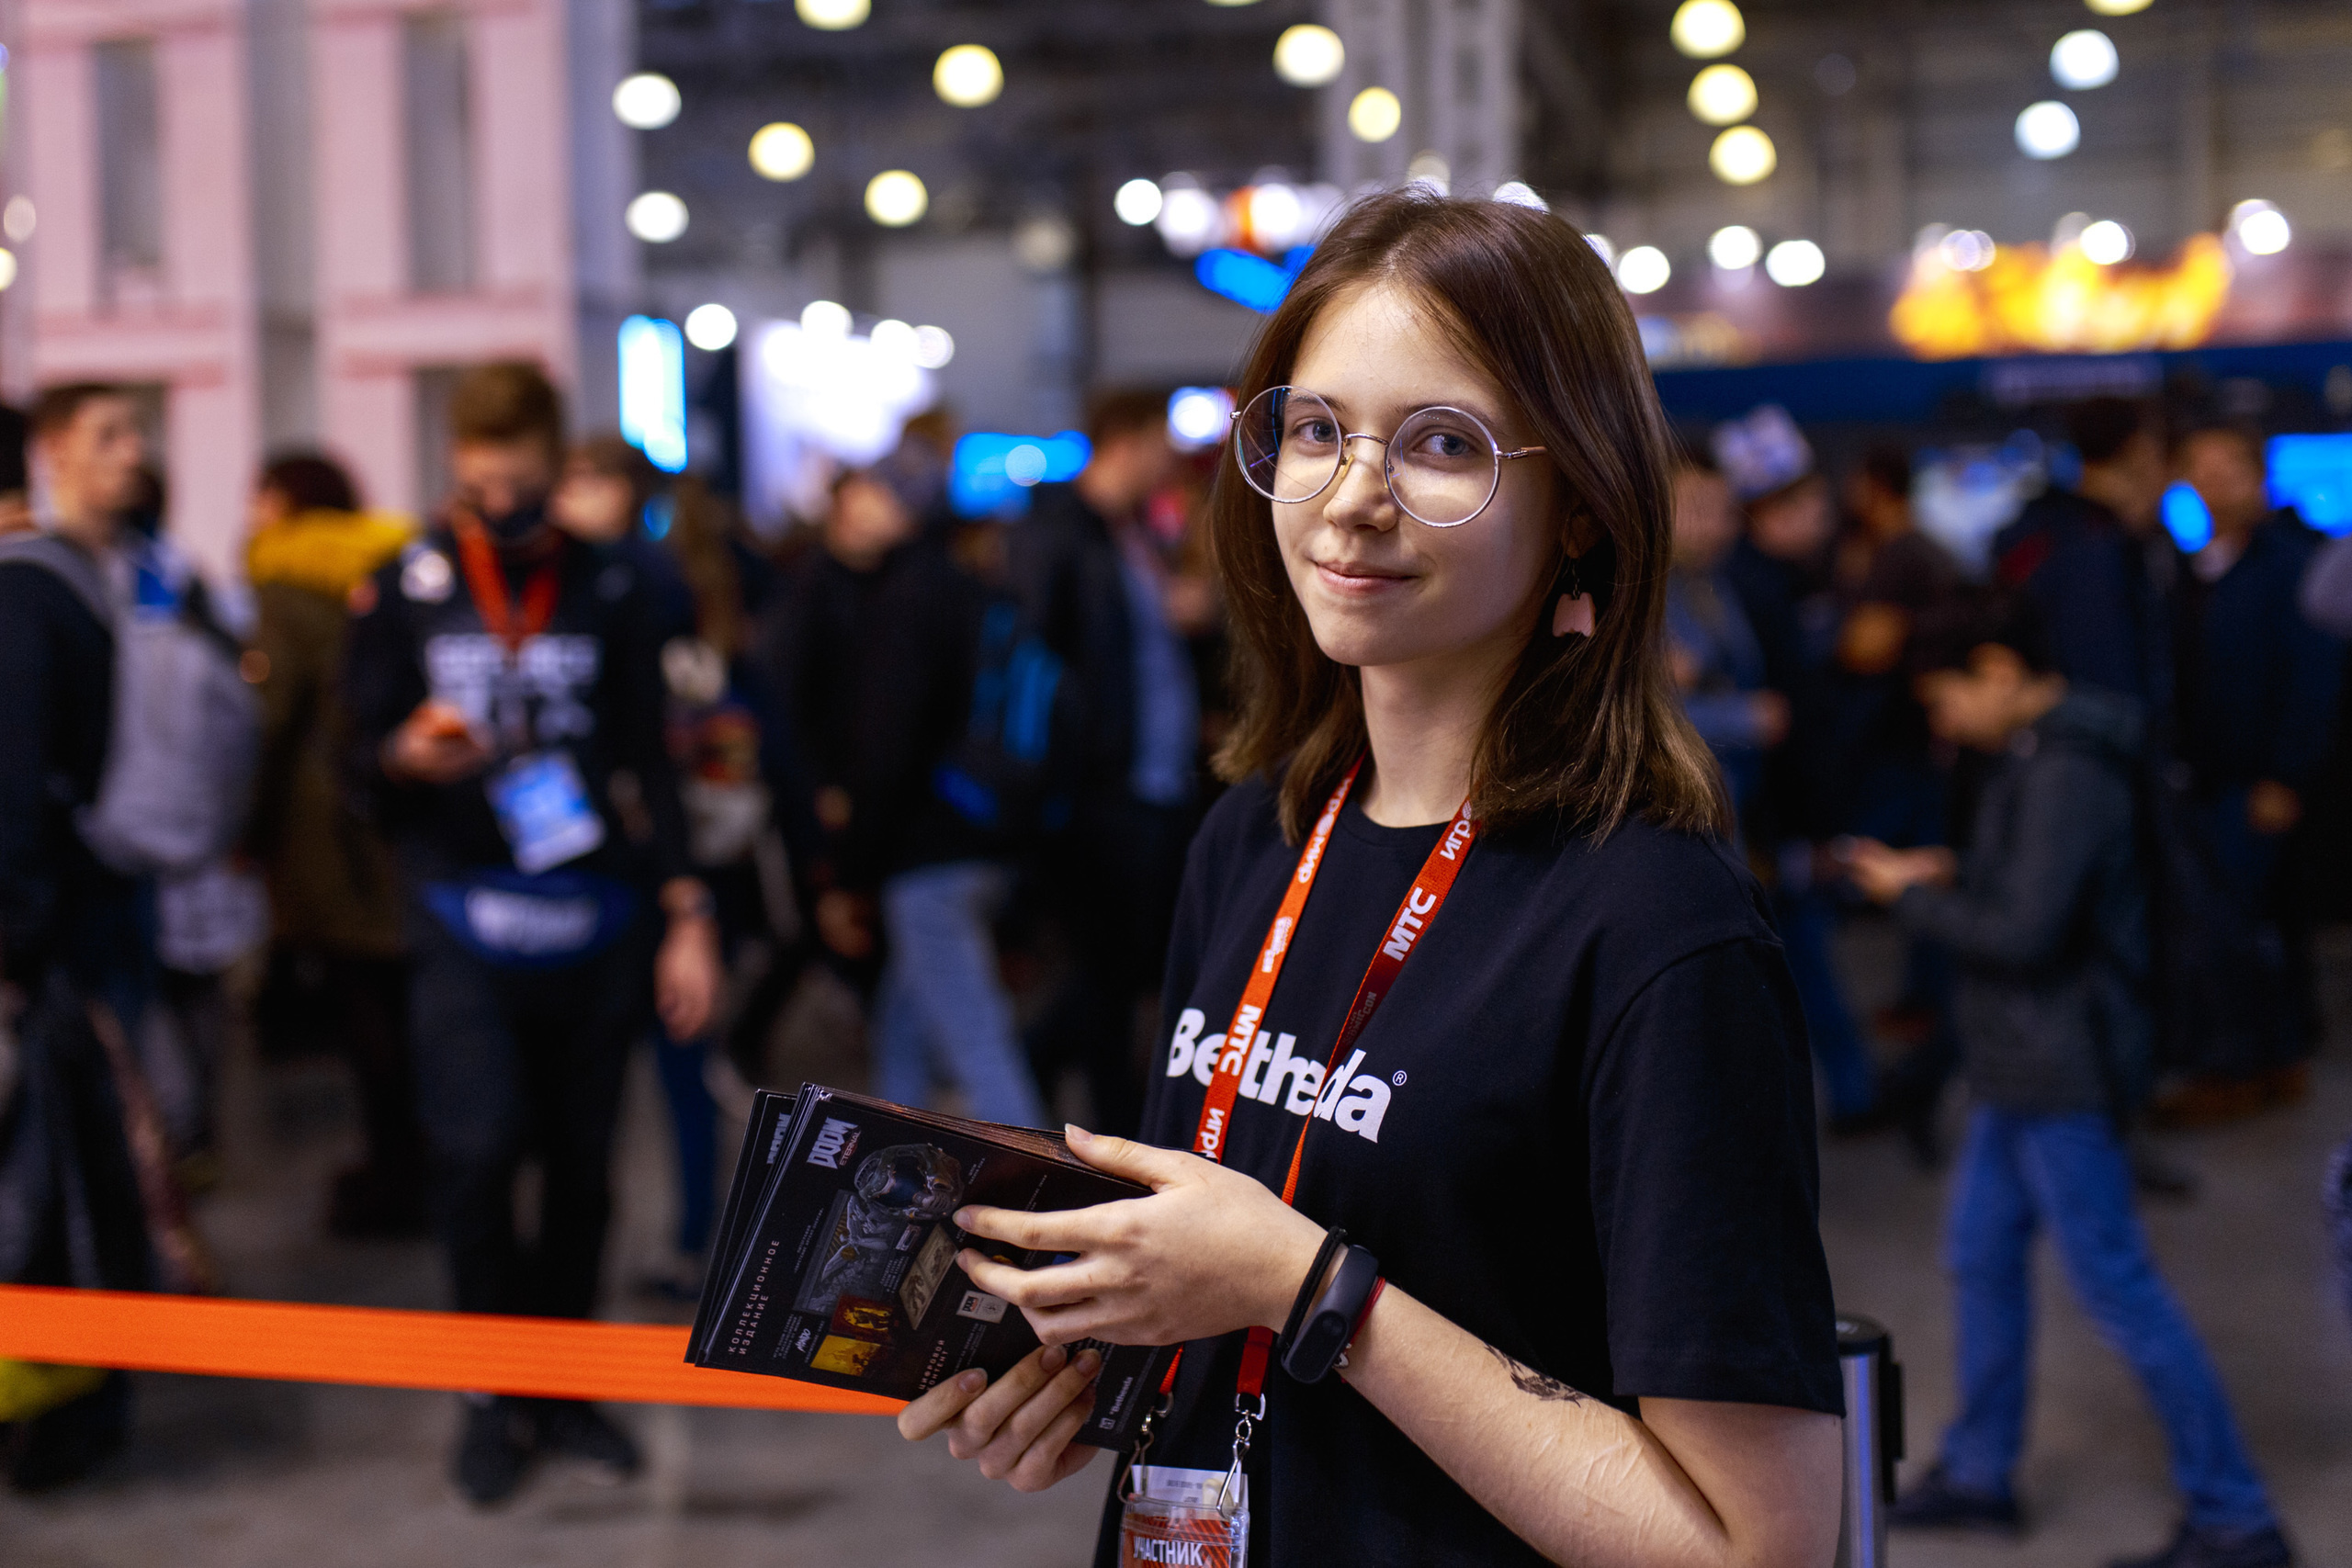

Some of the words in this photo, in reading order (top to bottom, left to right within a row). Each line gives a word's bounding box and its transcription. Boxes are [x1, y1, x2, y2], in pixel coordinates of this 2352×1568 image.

[1383, 886, 1437, 962] МТС
[1219, 1004, 1262, 1077] МТС
[1166, 1008, 1392, 1144] Betheda
[806, 1116, 859, 1170] DOOM
[839, 1130, 862, 1166] ETERNAL
[729, 1240, 780, 1354] КОЛЛЕКЦИОННОЕ
[739, 1295, 769, 1355] ИЗДАНИЕ
[1133, 1536, 1204, 1567] УЧАСТНИК
